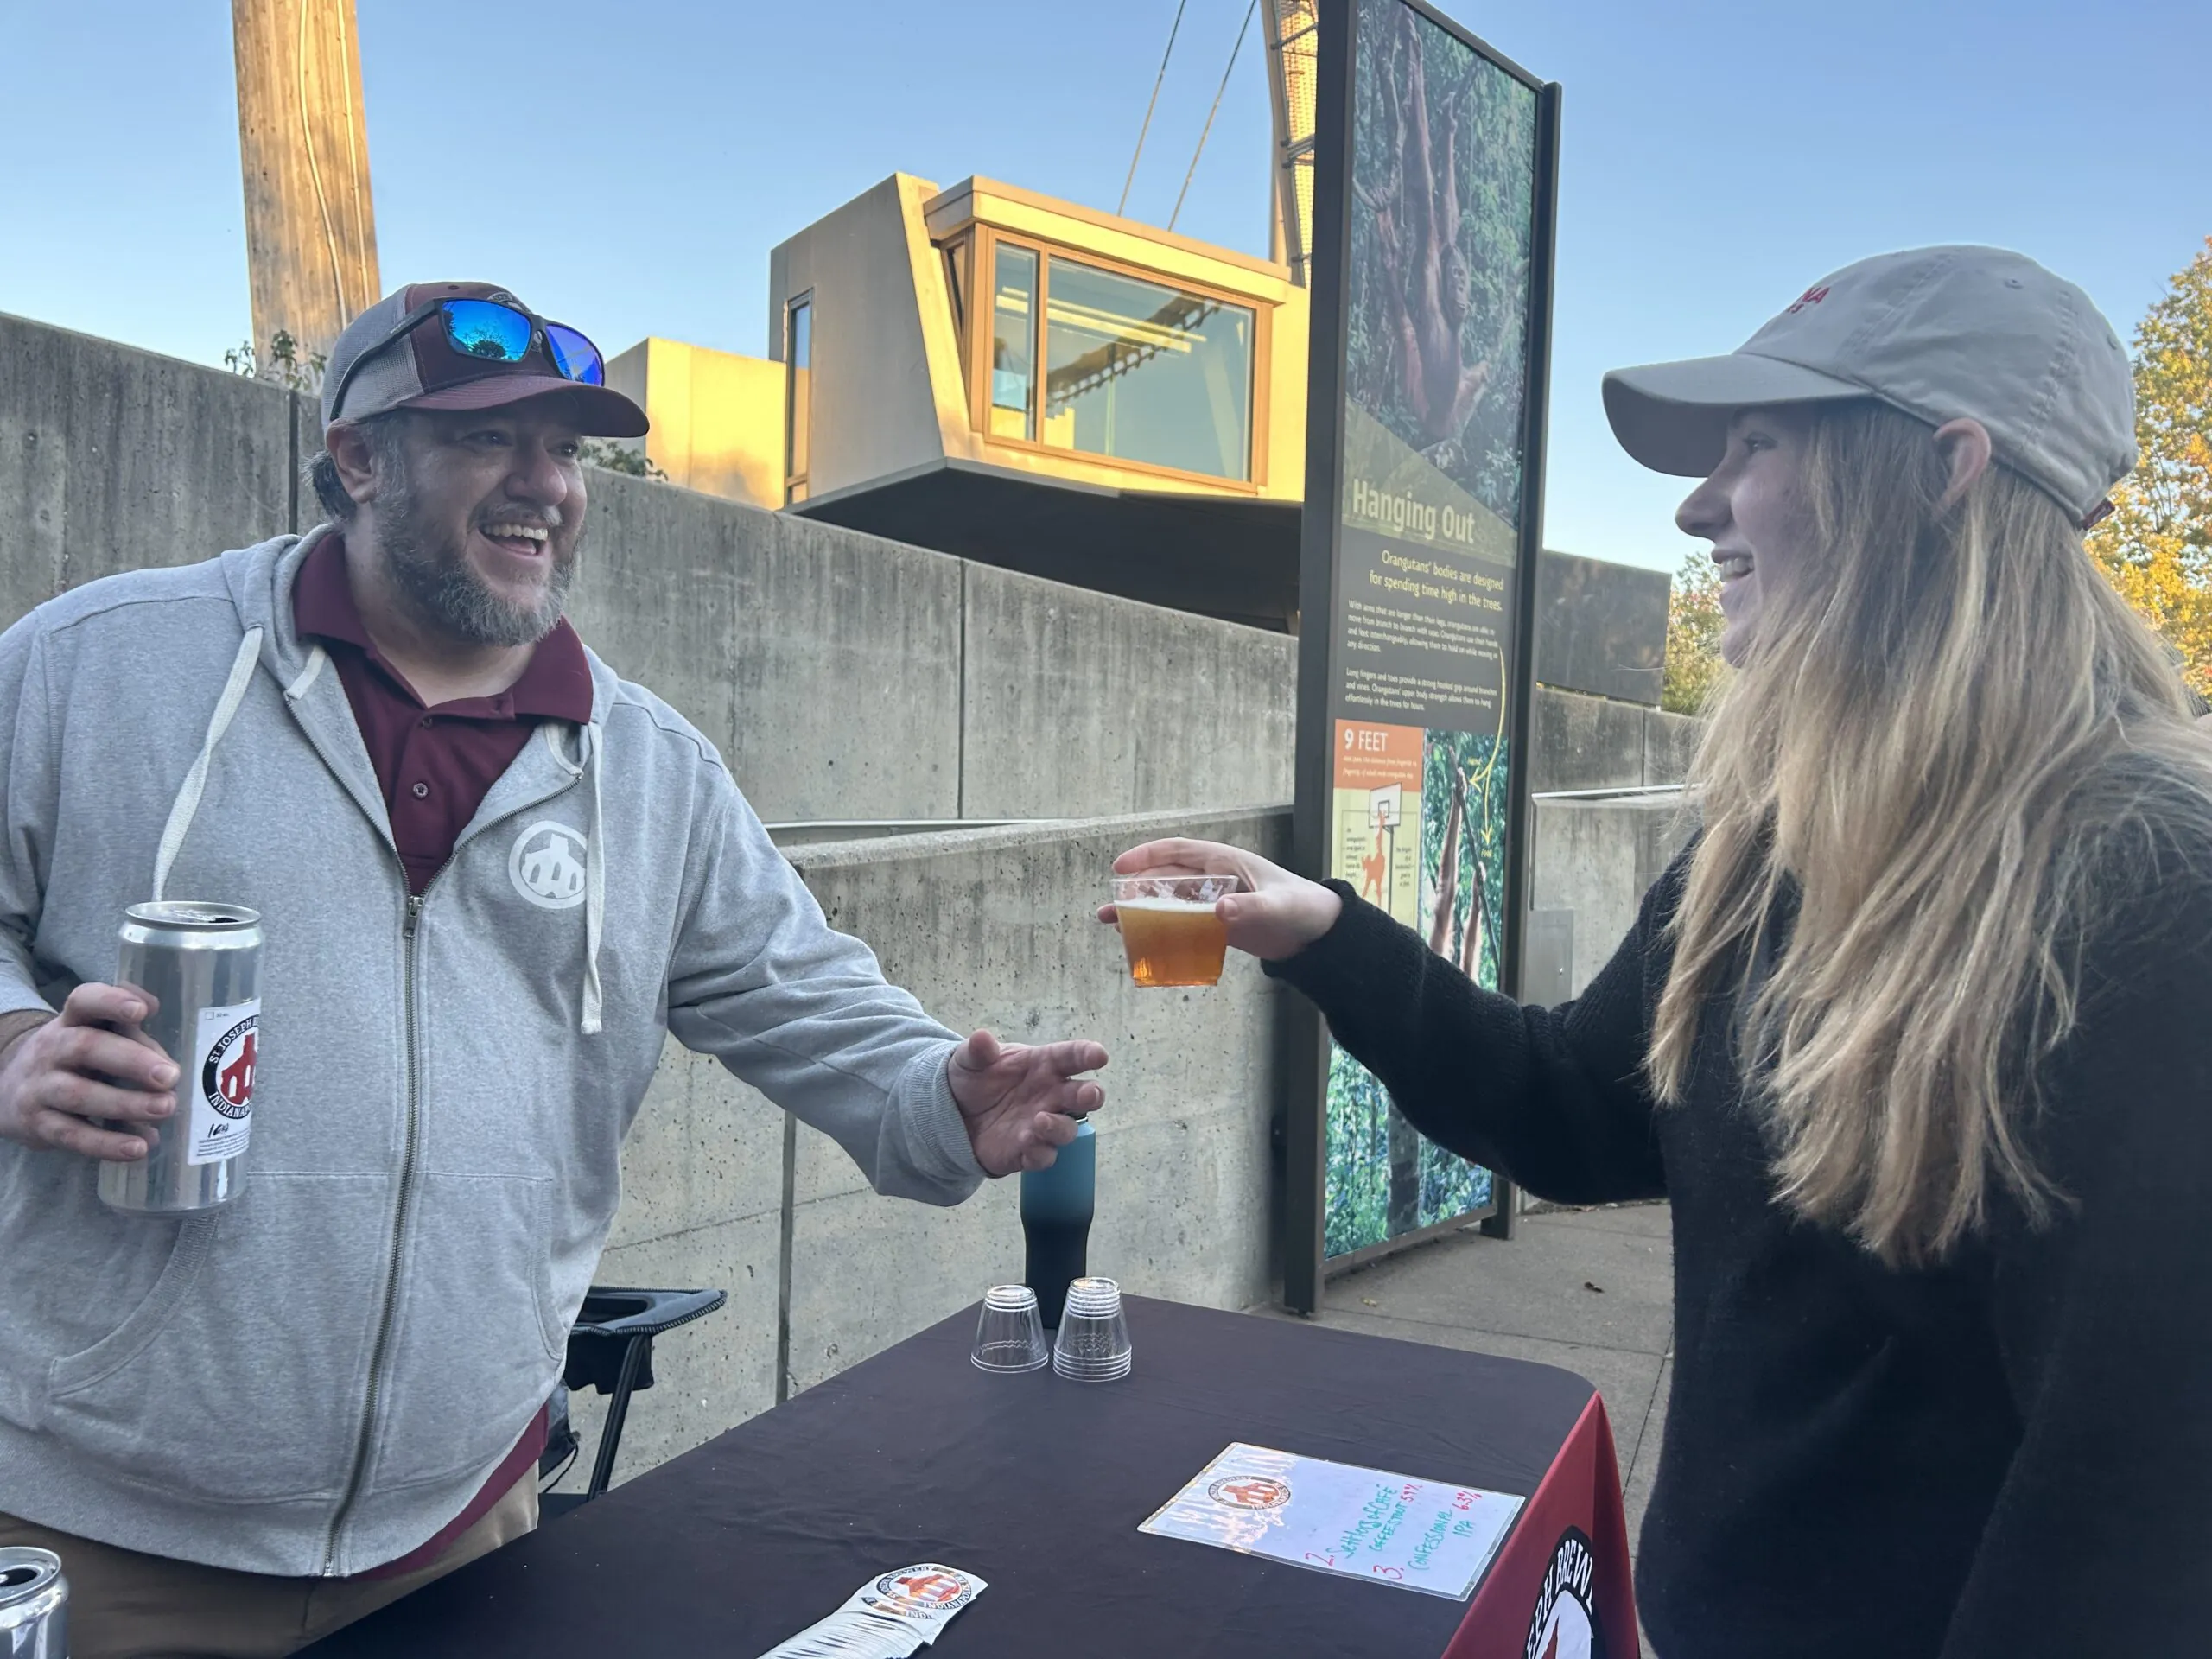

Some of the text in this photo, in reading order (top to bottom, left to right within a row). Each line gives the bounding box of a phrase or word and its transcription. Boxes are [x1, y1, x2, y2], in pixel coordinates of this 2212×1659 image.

[1353, 478, 1475, 544] Hanging Out
[1370, 570, 1503, 612] for spending time high in the trees.
[1382, 550, 1504, 592] Orangutans' bodies are designed
[1344, 728, 1389, 752] 9 FEET
[208, 1018, 252, 1064] ST JOSEPH
[1452, 1490, 1483, 1538] IPA 6.3%
[1305, 1552, 1335, 1567] 2.
[1373, 1564, 1404, 1580] 3.
